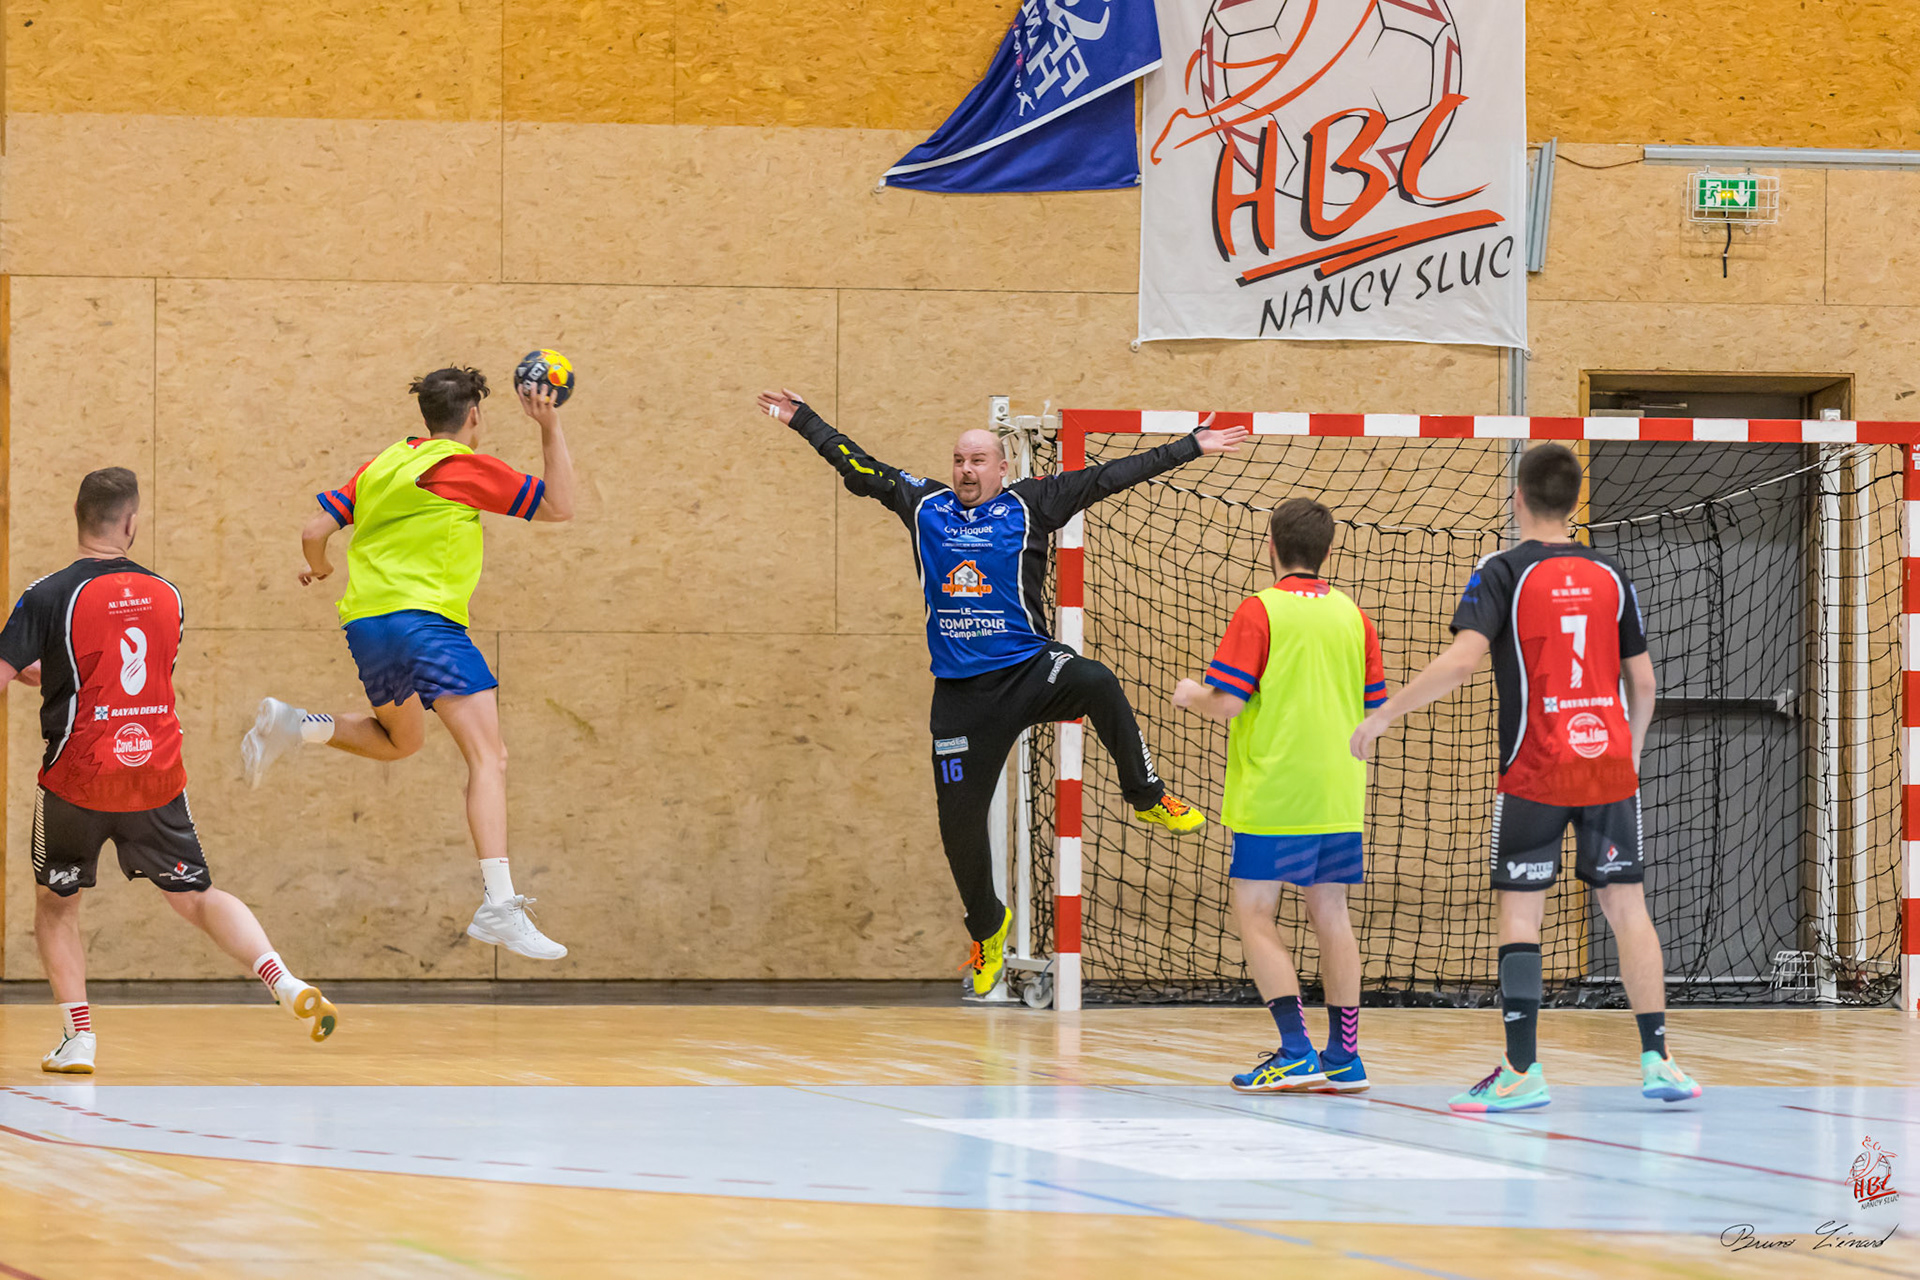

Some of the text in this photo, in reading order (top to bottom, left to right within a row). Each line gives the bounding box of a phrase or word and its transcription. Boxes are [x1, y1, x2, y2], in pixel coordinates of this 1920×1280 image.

[1212, 93, 1492, 262] HBC
[1259, 235, 1514, 337] NANCY SLUC
[960, 524, 993, 536] Hoquet
[120, 597, 151, 607] BUREAU
[940, 618, 1005, 630] COMPTOIR
[949, 628, 992, 640] Campanile
[1560, 614, 1587, 688] 7
[119, 627, 147, 696] 8
[111, 707, 139, 717] RAYAN
[116, 739, 133, 753] Cave
[136, 736, 153, 751] Léon
[940, 758, 964, 784] 16
